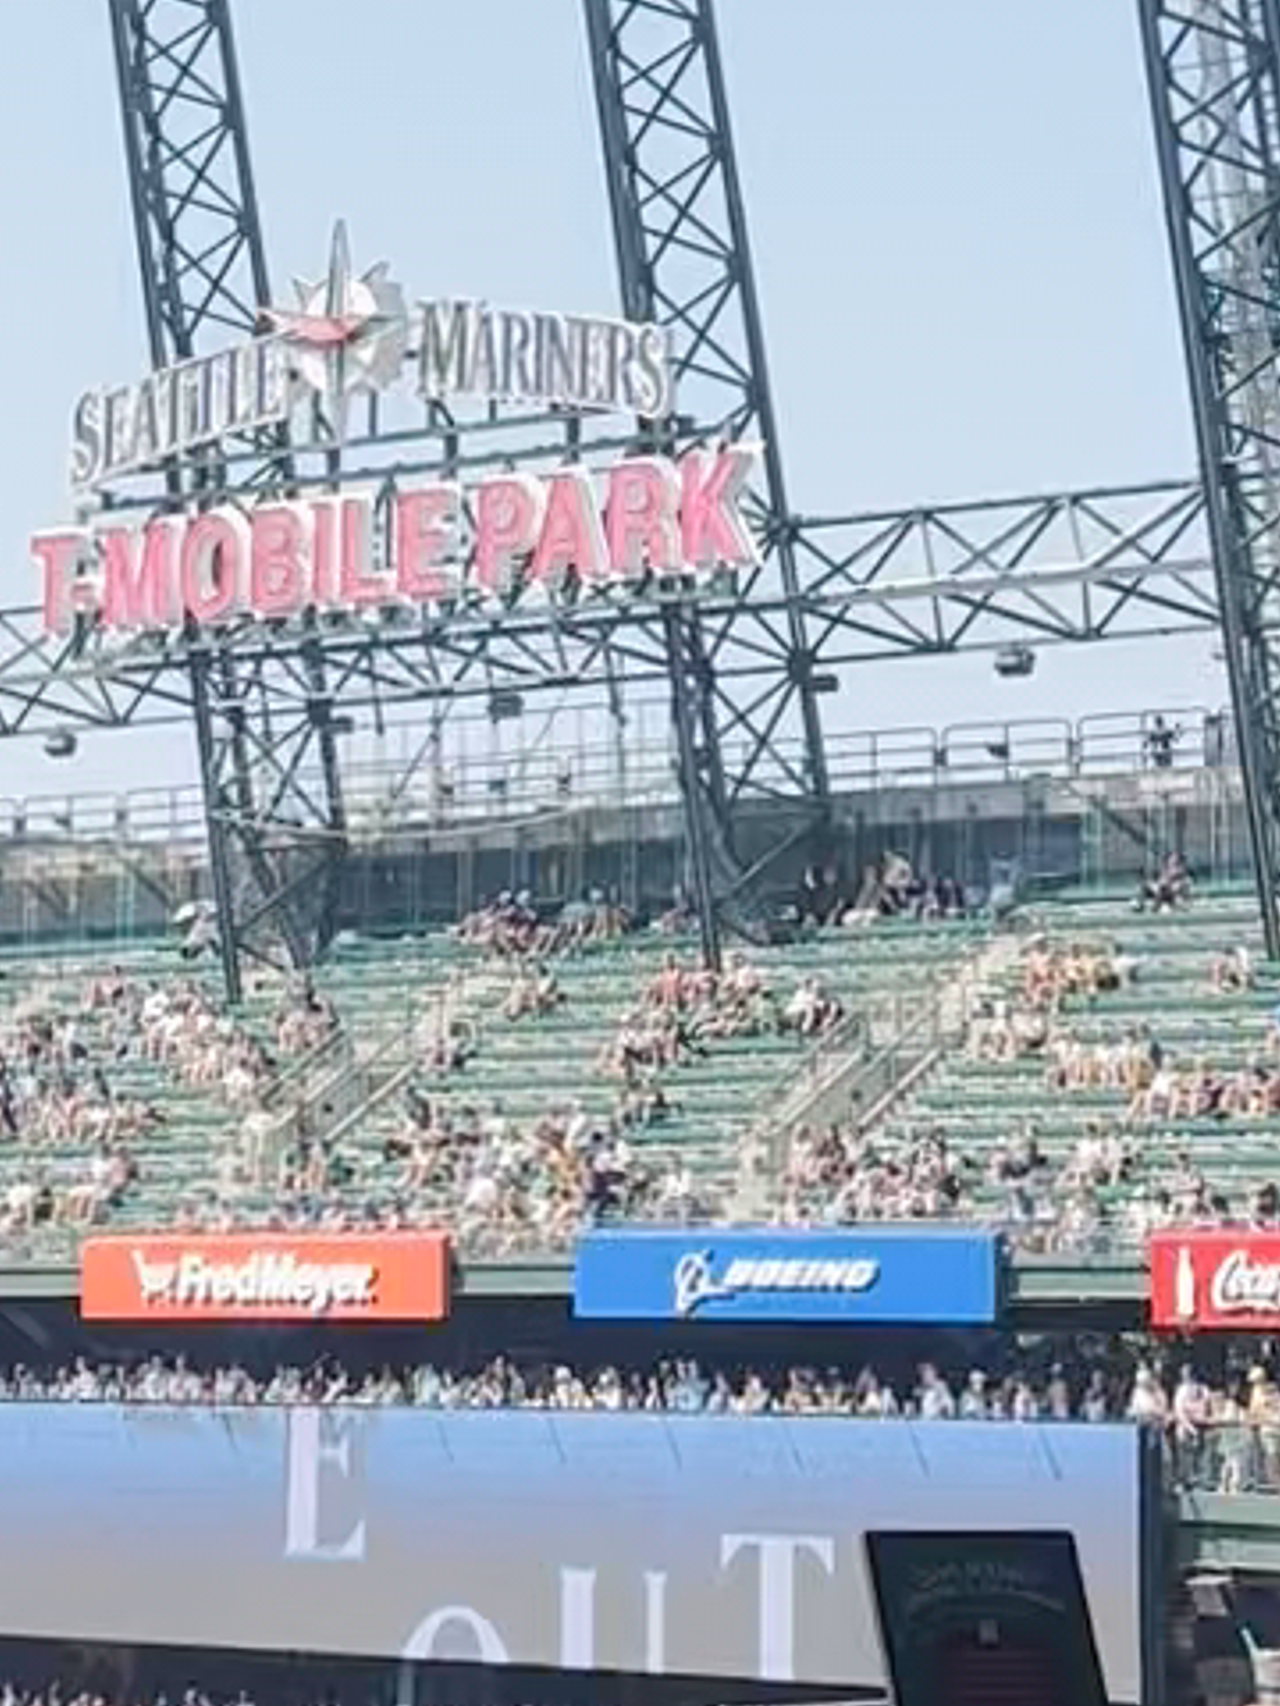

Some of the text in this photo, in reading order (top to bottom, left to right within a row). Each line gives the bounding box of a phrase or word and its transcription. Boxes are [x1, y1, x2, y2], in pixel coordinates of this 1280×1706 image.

[70, 298, 676, 488] SEATTLE MARINERS
[468, 444, 768, 598] PARK
[723, 1259, 878, 1290] BOEING
